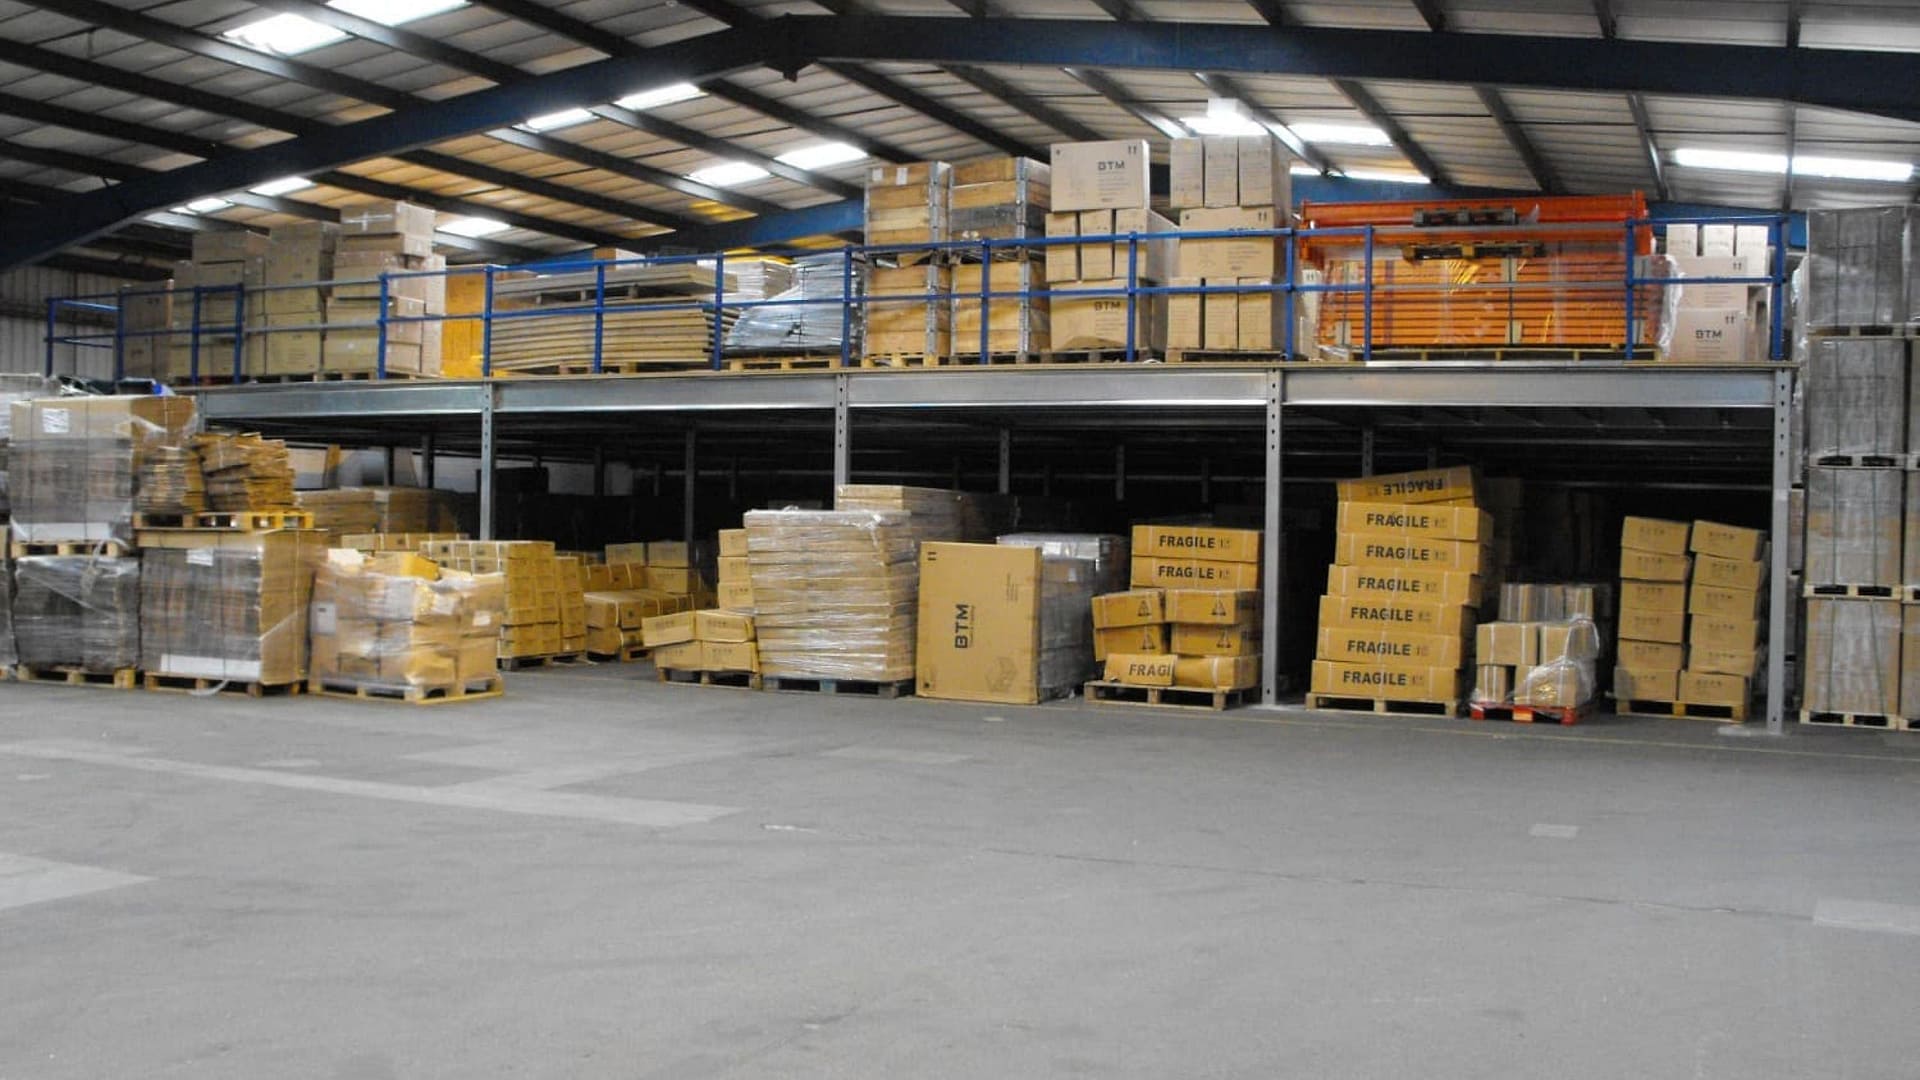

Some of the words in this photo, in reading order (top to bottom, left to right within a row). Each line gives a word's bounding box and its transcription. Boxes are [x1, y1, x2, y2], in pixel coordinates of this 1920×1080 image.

[1383, 478, 1443, 495] FRAGILE
[1366, 513, 1429, 528] FRAGILE
[1159, 535, 1216, 548] FRAGILE
[1366, 545, 1429, 560] FRAGILE
[1158, 565, 1214, 579] FRAGLE
[1357, 577, 1420, 593] FRAGILE
[1350, 606, 1413, 622] FRAGILE
[955, 603, 969, 649] BTM
[1347, 639, 1411, 656] FRAGILE
[1342, 670, 1407, 686] FRAGILE
